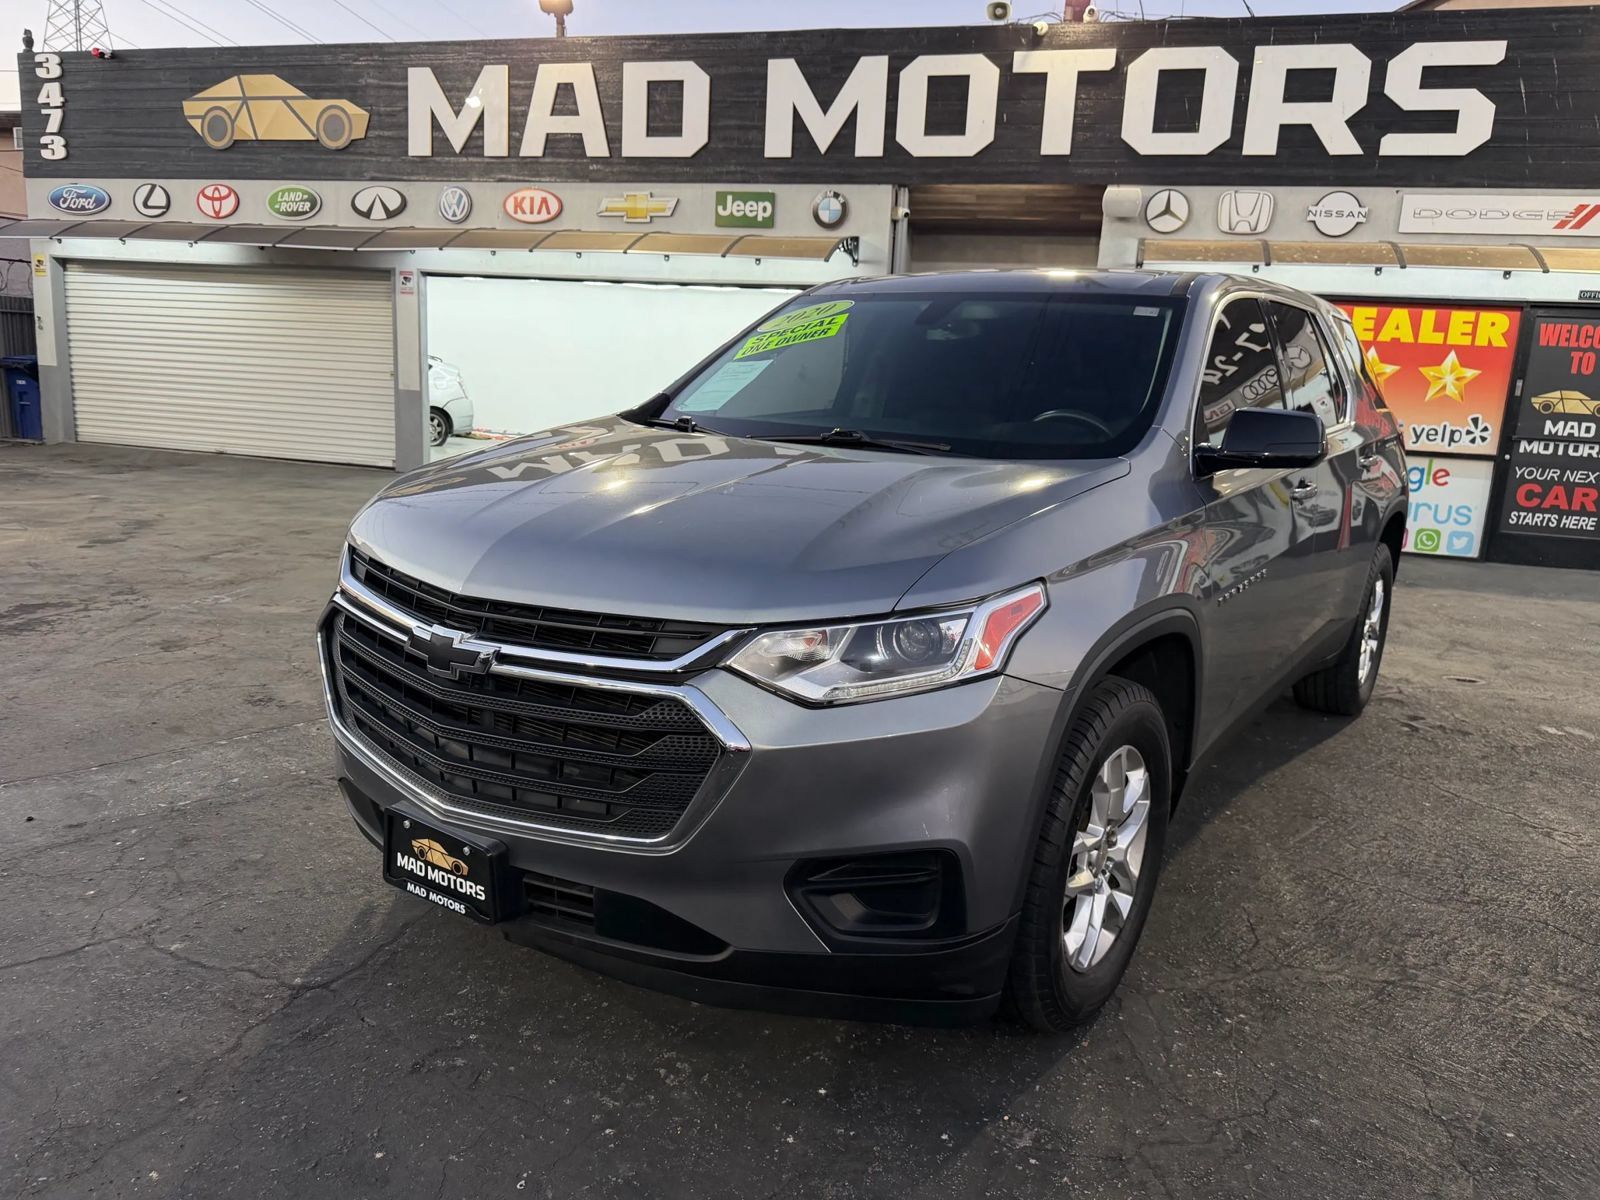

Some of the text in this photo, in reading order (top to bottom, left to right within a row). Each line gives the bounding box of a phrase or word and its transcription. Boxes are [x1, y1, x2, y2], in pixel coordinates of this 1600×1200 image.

[34, 53, 68, 160] 3473
[407, 40, 1508, 158] MAD MOTORS
[59, 188, 97, 210] Ford
[278, 192, 302, 201] LAND
[280, 202, 311, 212] ROVER
[513, 196, 551, 215] KIA
[717, 195, 772, 221] Jeep
[1307, 208, 1368, 219] NISSAN
[1413, 207, 1574, 221] DODGE
[754, 317, 838, 344] SPECIAL
[1352, 306, 1510, 348] EALER
[742, 327, 832, 356] ONE OWNER
[1570, 351, 1596, 375] TO
[1412, 424, 1462, 447] yelp
[1544, 420, 1596, 438] MAD
[1519, 440, 1600, 458] MOTOR
[1515, 466, 1600, 484] YOUR NEX
[1516, 483, 1598, 512] CAR
[1509, 511, 1598, 531] STARTS HERE
[397, 852, 486, 900] MAD MOTORS
[407, 882, 466, 915] MAD MOTORS
